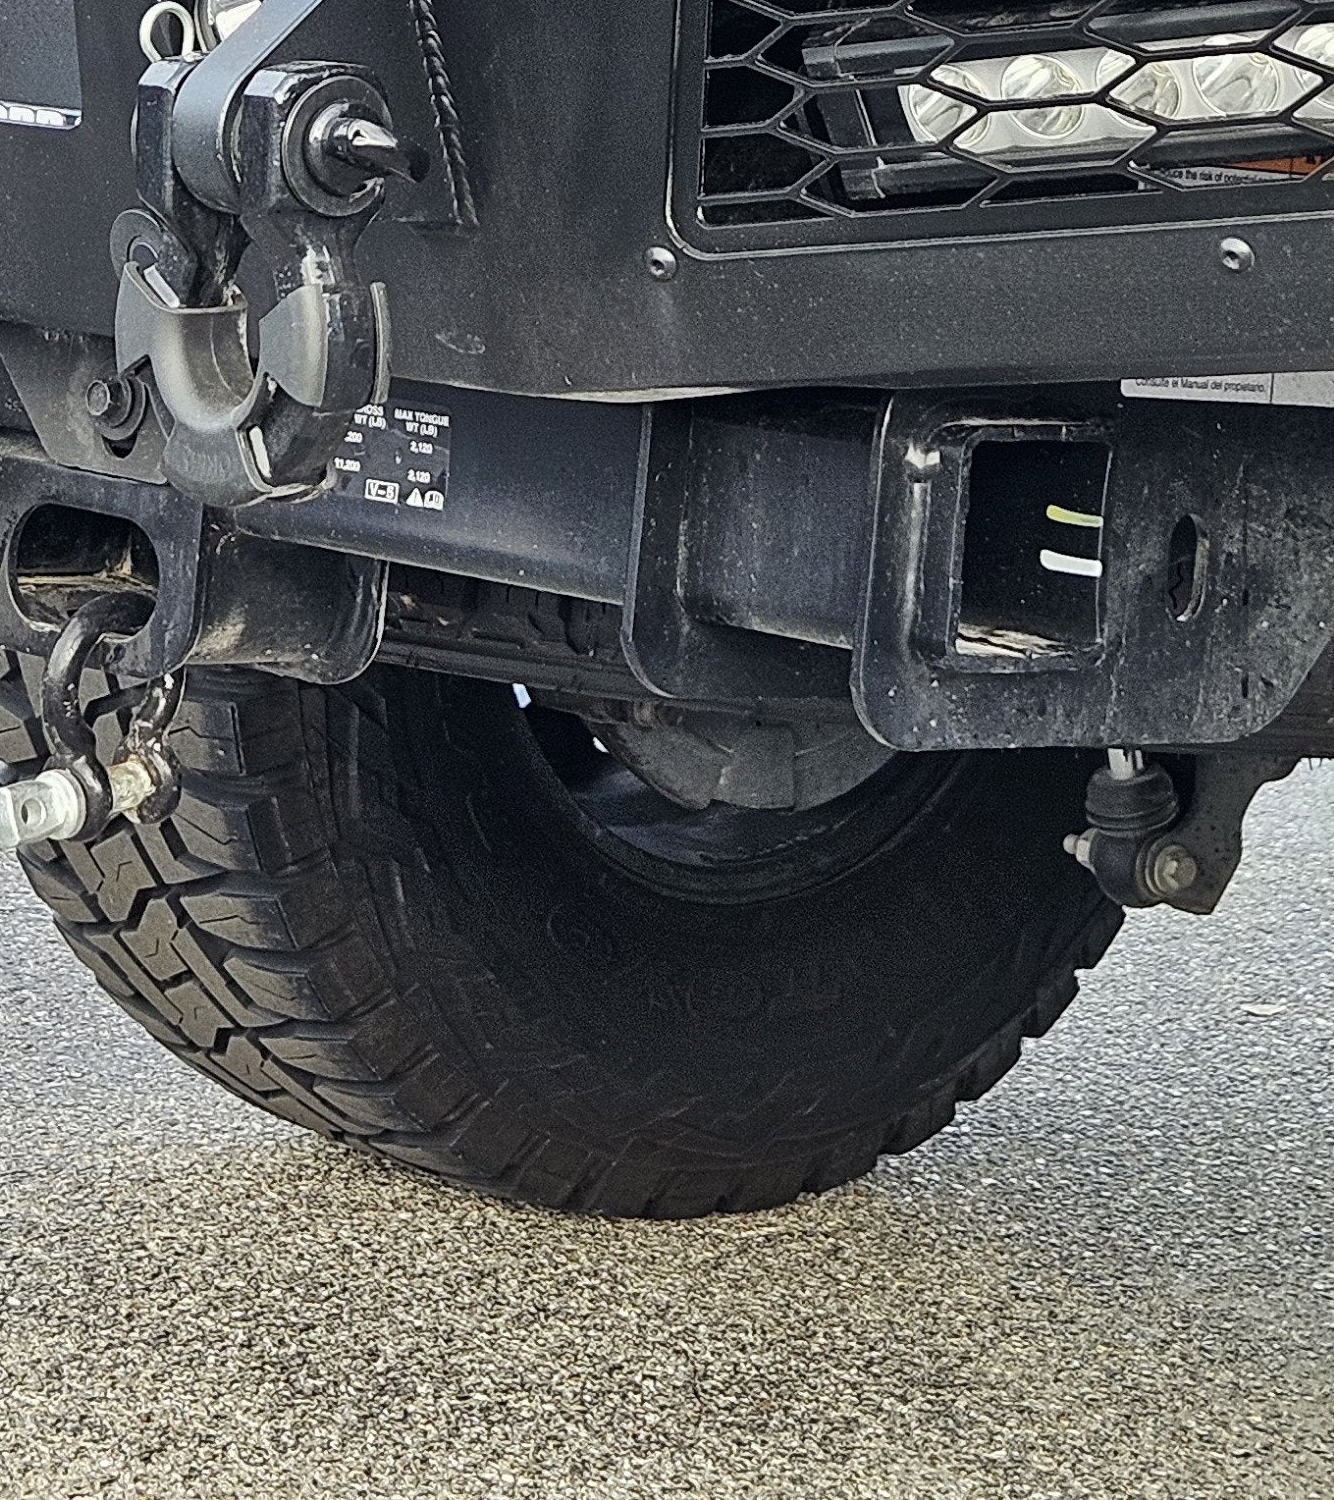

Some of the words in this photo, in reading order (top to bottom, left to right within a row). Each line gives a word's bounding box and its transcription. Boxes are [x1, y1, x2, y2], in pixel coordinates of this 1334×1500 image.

[1181, 378, 1209, 389] Manual
[394, 408, 414, 421] MAX
[415, 411, 450, 428] TONGUE
[405, 421, 419, 433] WT
[409, 440, 434, 455] 2,120
[407, 468, 431, 484] 2,120
